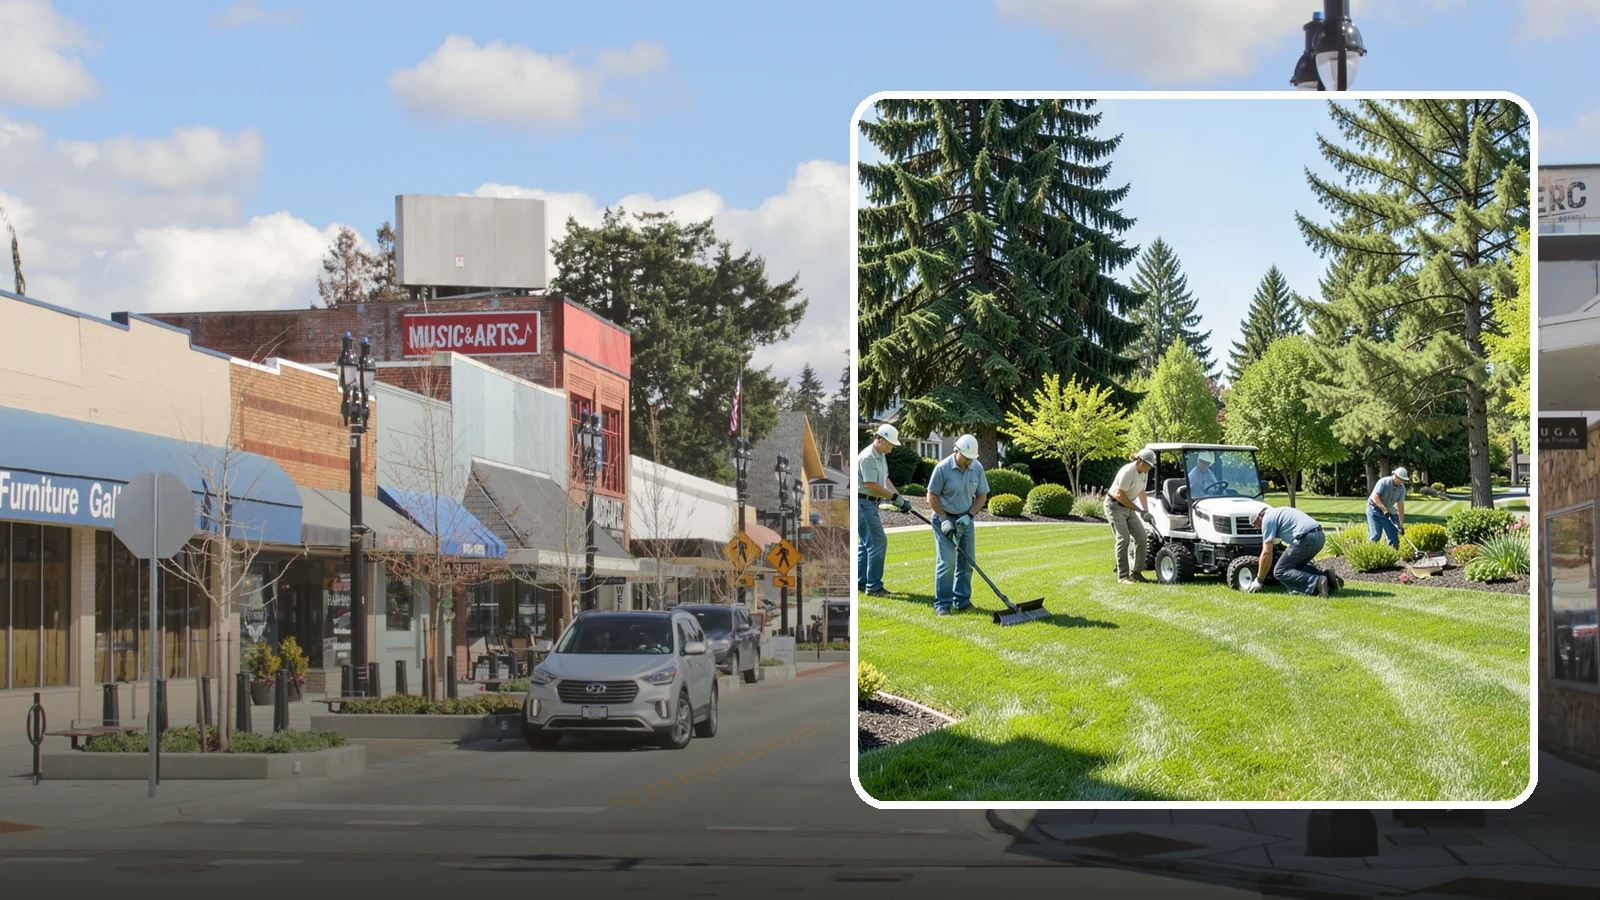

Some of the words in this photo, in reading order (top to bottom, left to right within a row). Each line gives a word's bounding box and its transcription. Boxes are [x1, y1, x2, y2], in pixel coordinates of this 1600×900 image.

[409, 323, 519, 349] MUSIC&ARTS
[0, 472, 79, 515] Furniture
[90, 482, 121, 519] Gal
